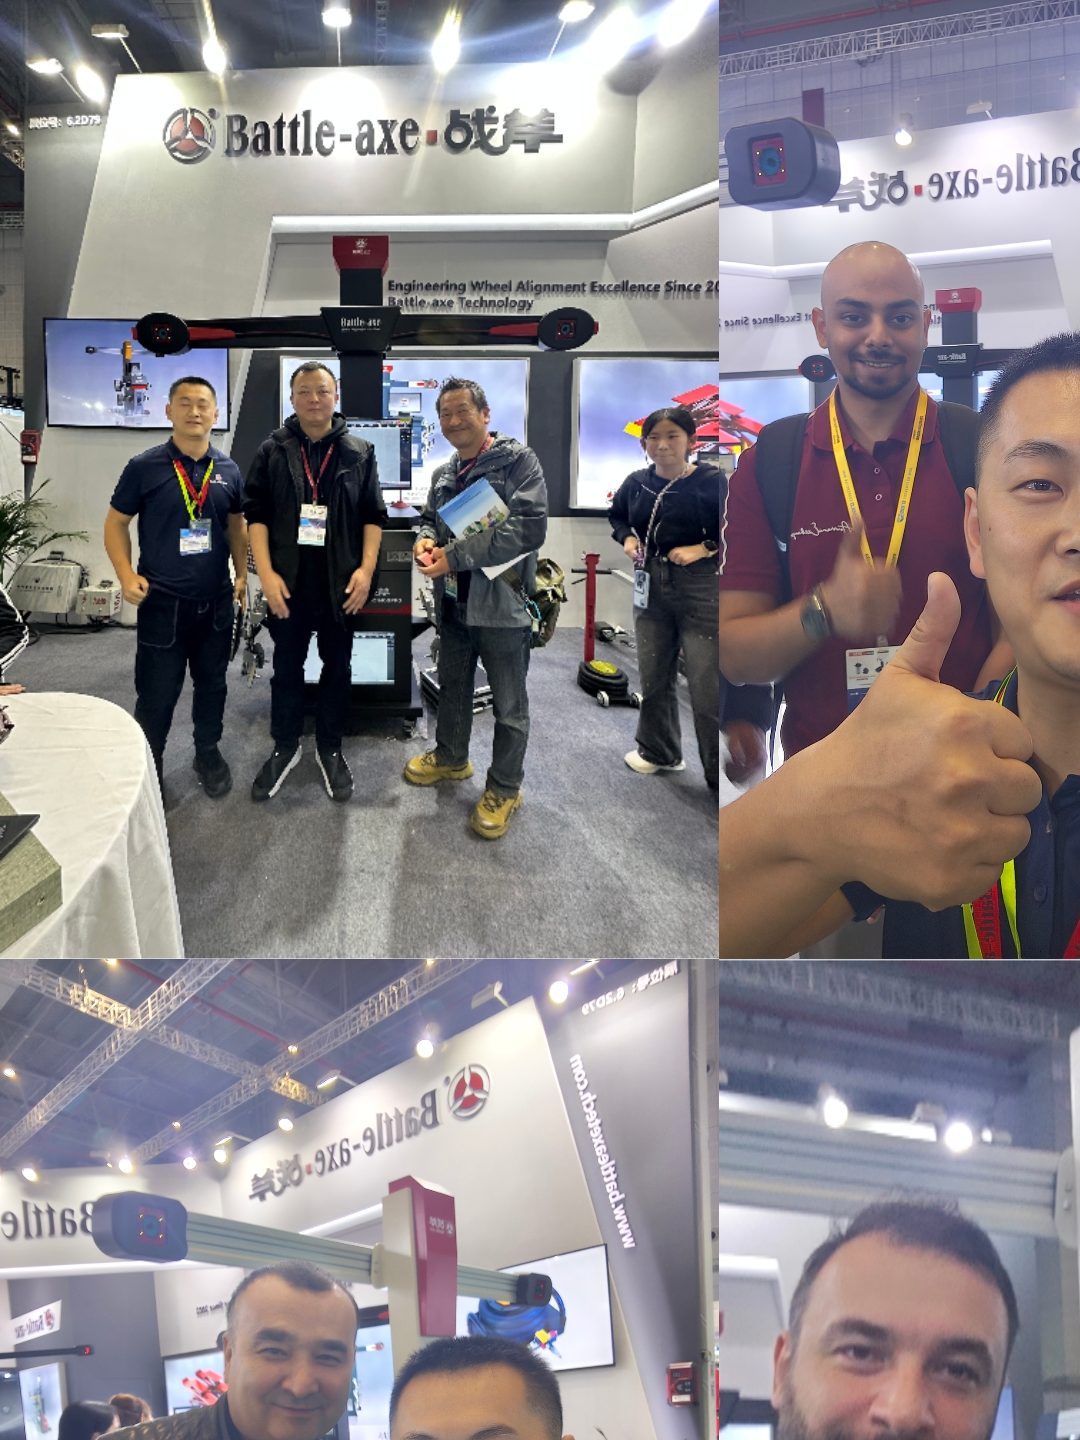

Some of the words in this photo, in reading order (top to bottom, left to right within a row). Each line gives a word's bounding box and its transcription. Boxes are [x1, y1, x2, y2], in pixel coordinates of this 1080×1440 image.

[224, 109, 421, 158] Battle-axe
[388, 279, 467, 298] Engineering
[471, 280, 513, 294] Wheel
[516, 281, 587, 299] Alignment
[590, 281, 661, 295] Excellence
[665, 281, 703, 295] Since
[460, 296, 534, 313] Technology
